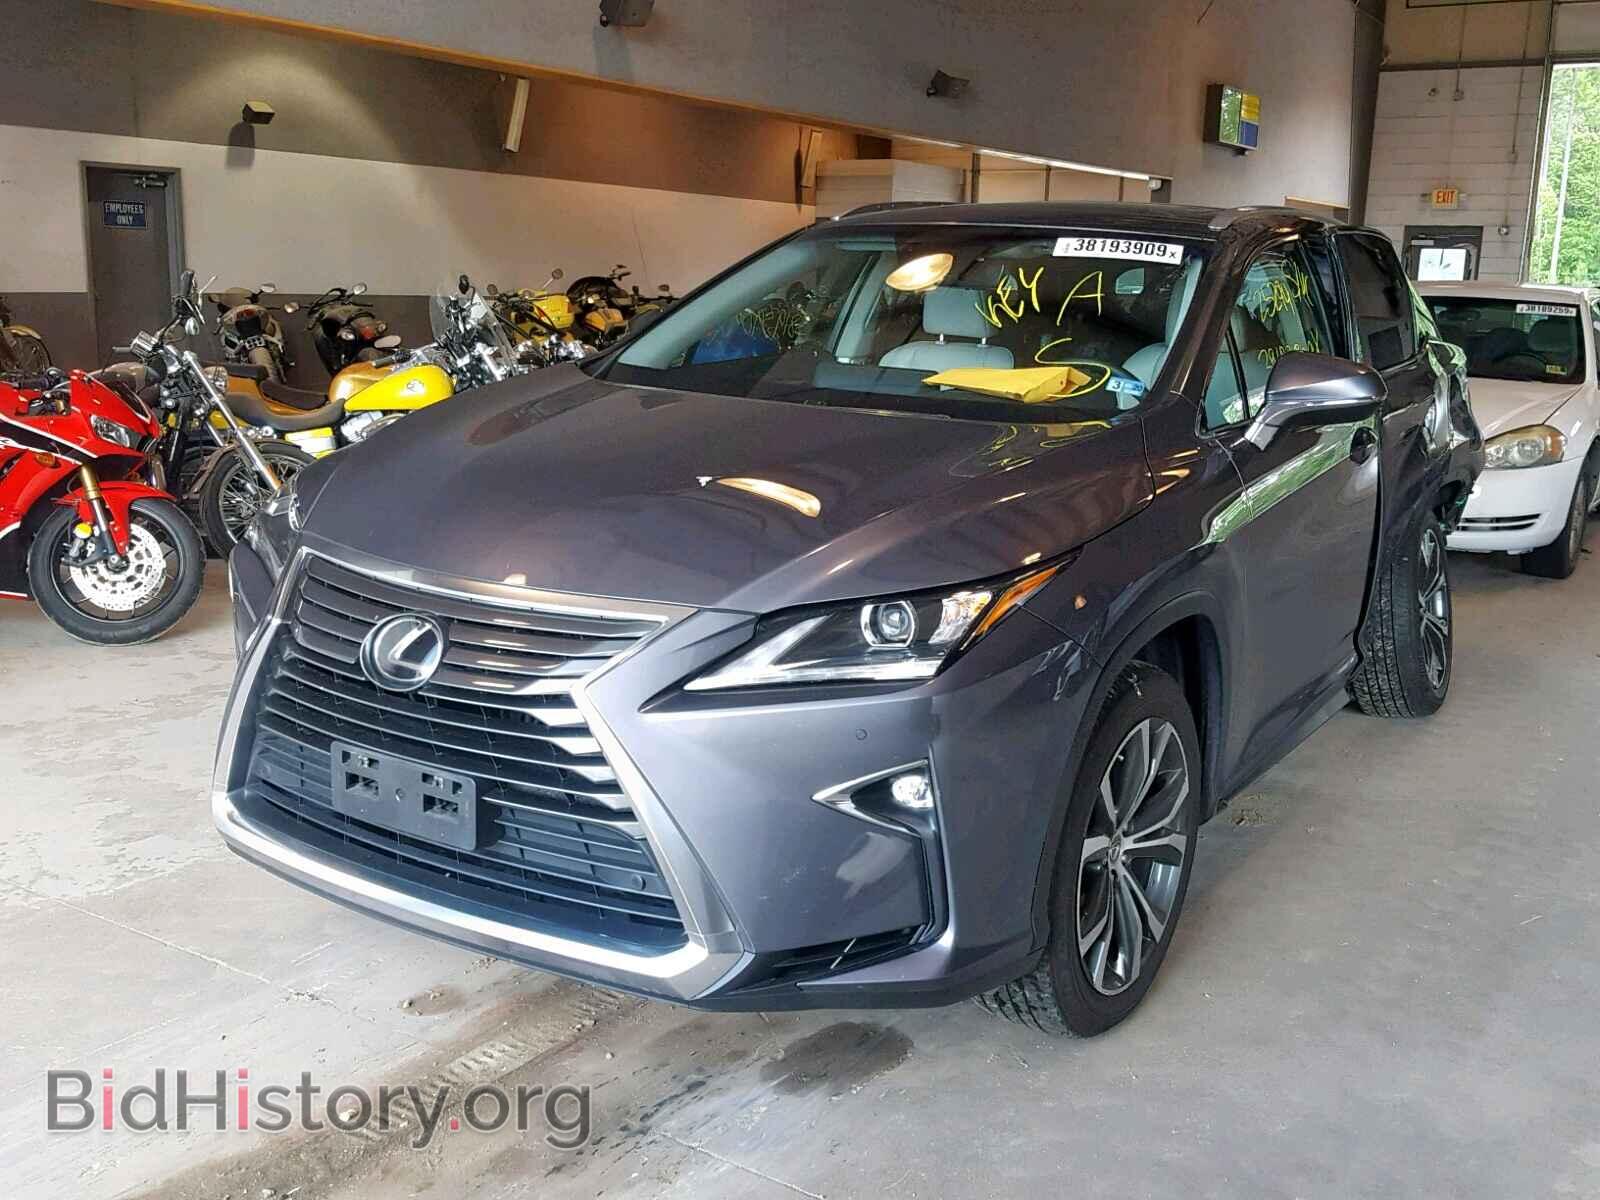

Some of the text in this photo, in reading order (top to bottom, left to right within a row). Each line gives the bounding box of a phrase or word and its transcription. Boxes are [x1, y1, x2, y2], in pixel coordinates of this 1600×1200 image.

[1435, 191, 1456, 204] EXIT
[105, 202, 144, 214] EMPLOYEES
[116, 215, 134, 225] ONLY
[975, 265, 1105, 328] KEY A
